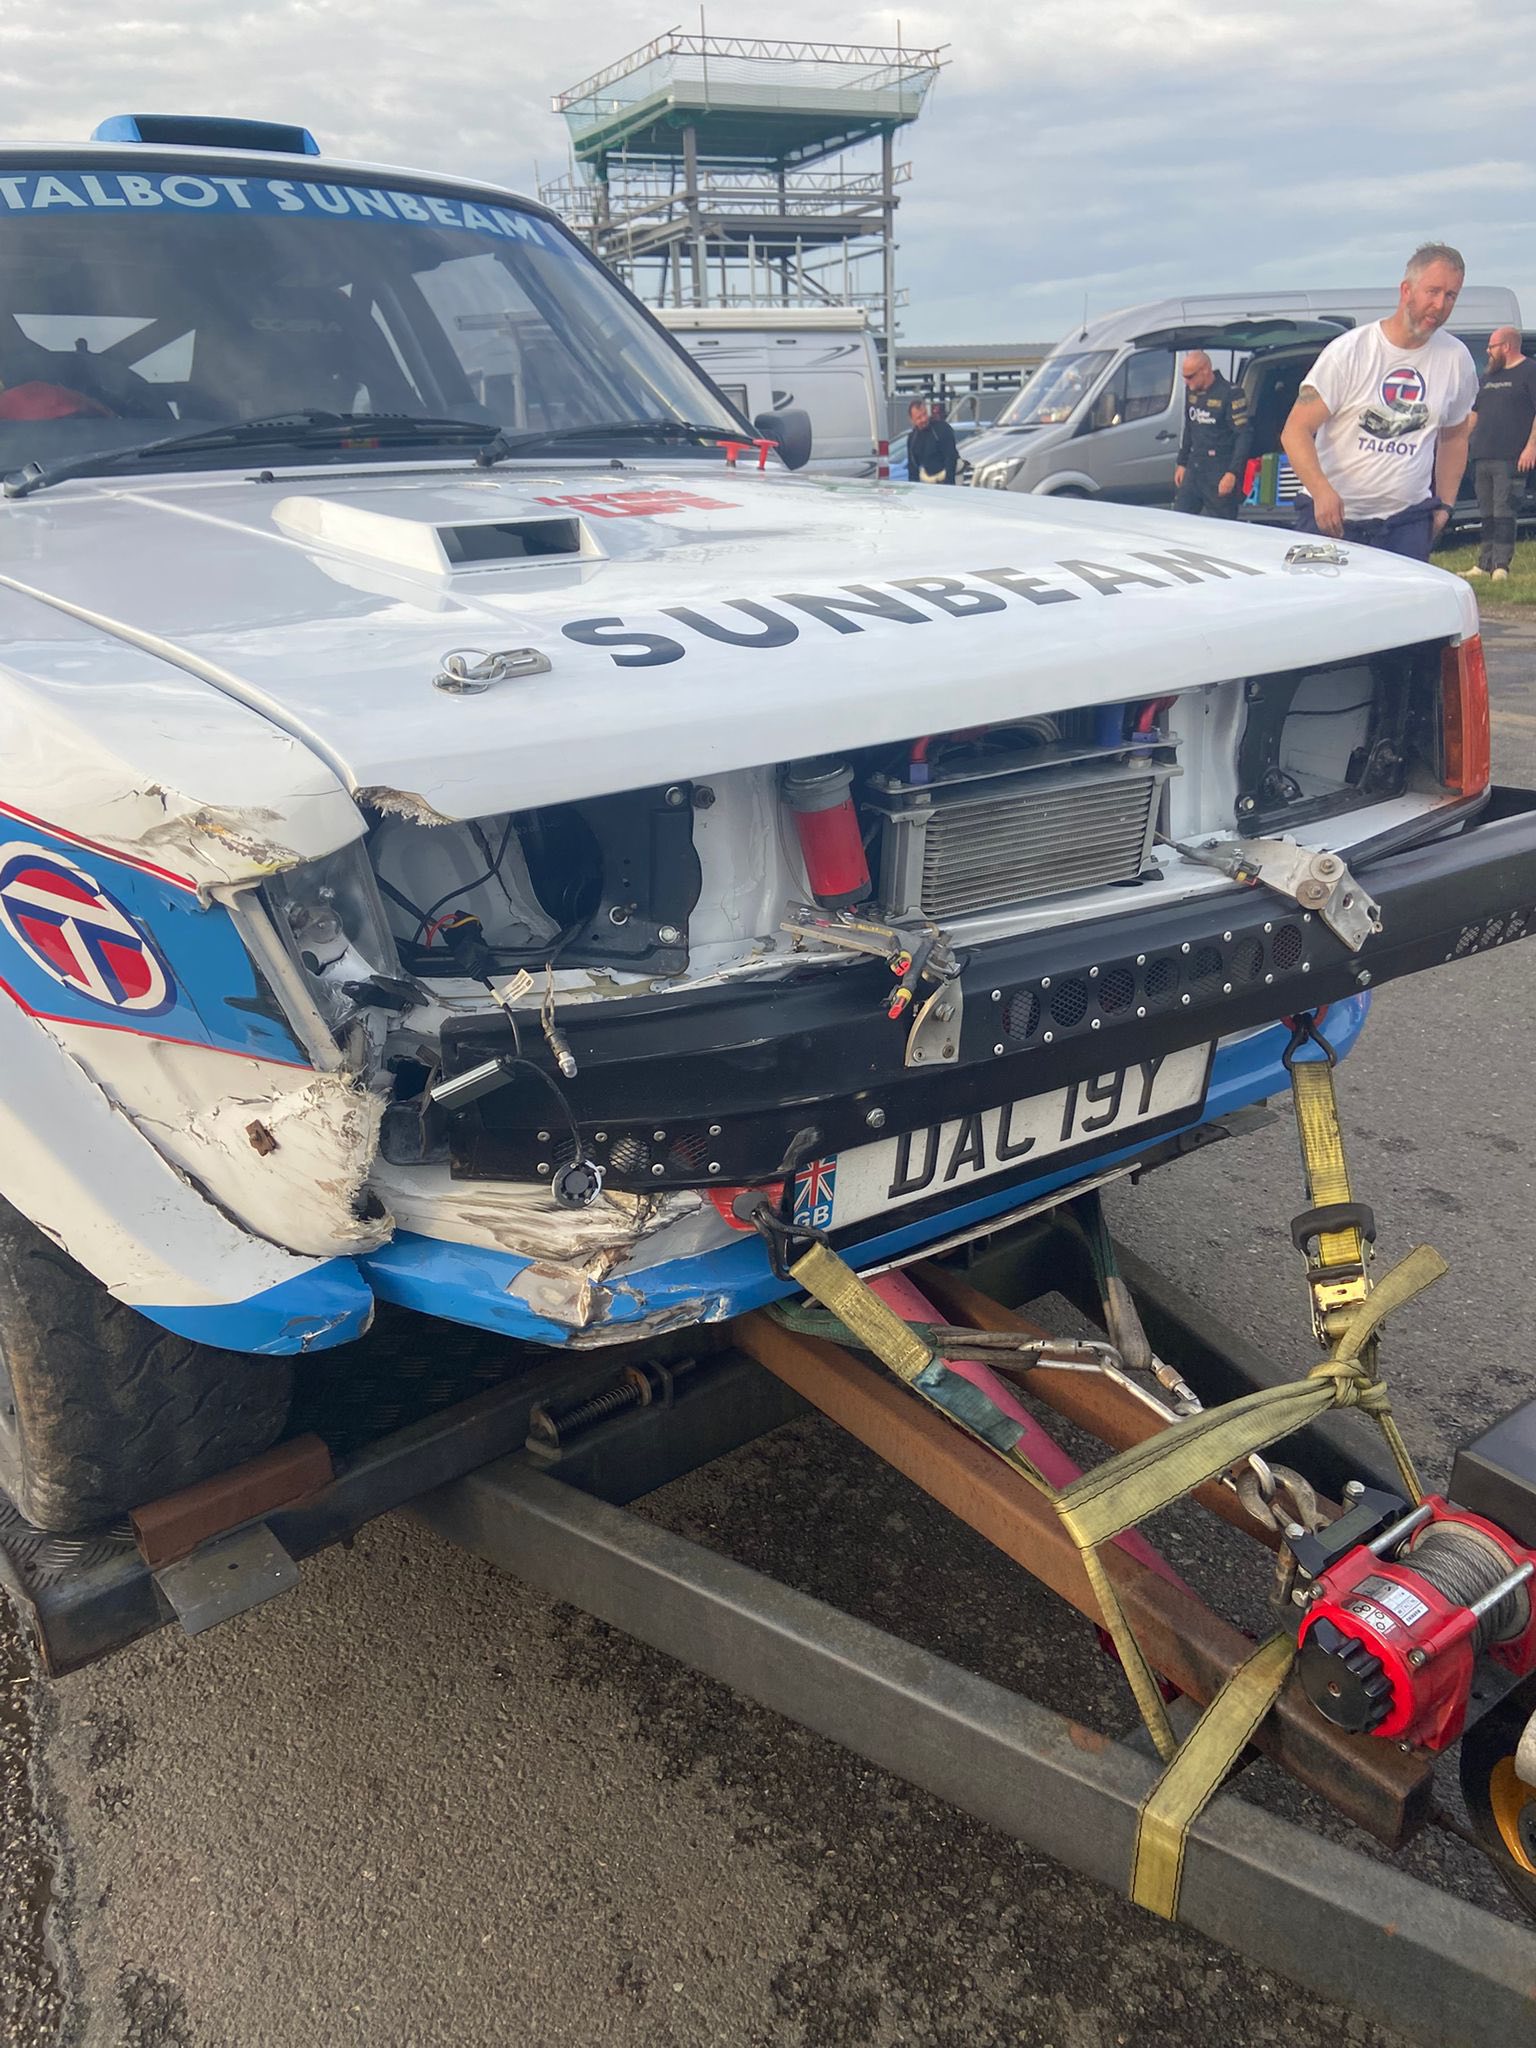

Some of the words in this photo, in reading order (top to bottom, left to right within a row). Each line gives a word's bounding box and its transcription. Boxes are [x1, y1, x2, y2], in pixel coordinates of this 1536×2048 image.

[0, 175, 251, 210] TALBOT
[266, 179, 546, 247] SUNBEAM
[1358, 437, 1417, 456] TALBOT
[561, 548, 1265, 668] SUNBEAM
[887, 1102, 1036, 1199] DAC
[793, 1205, 830, 1227] GB
